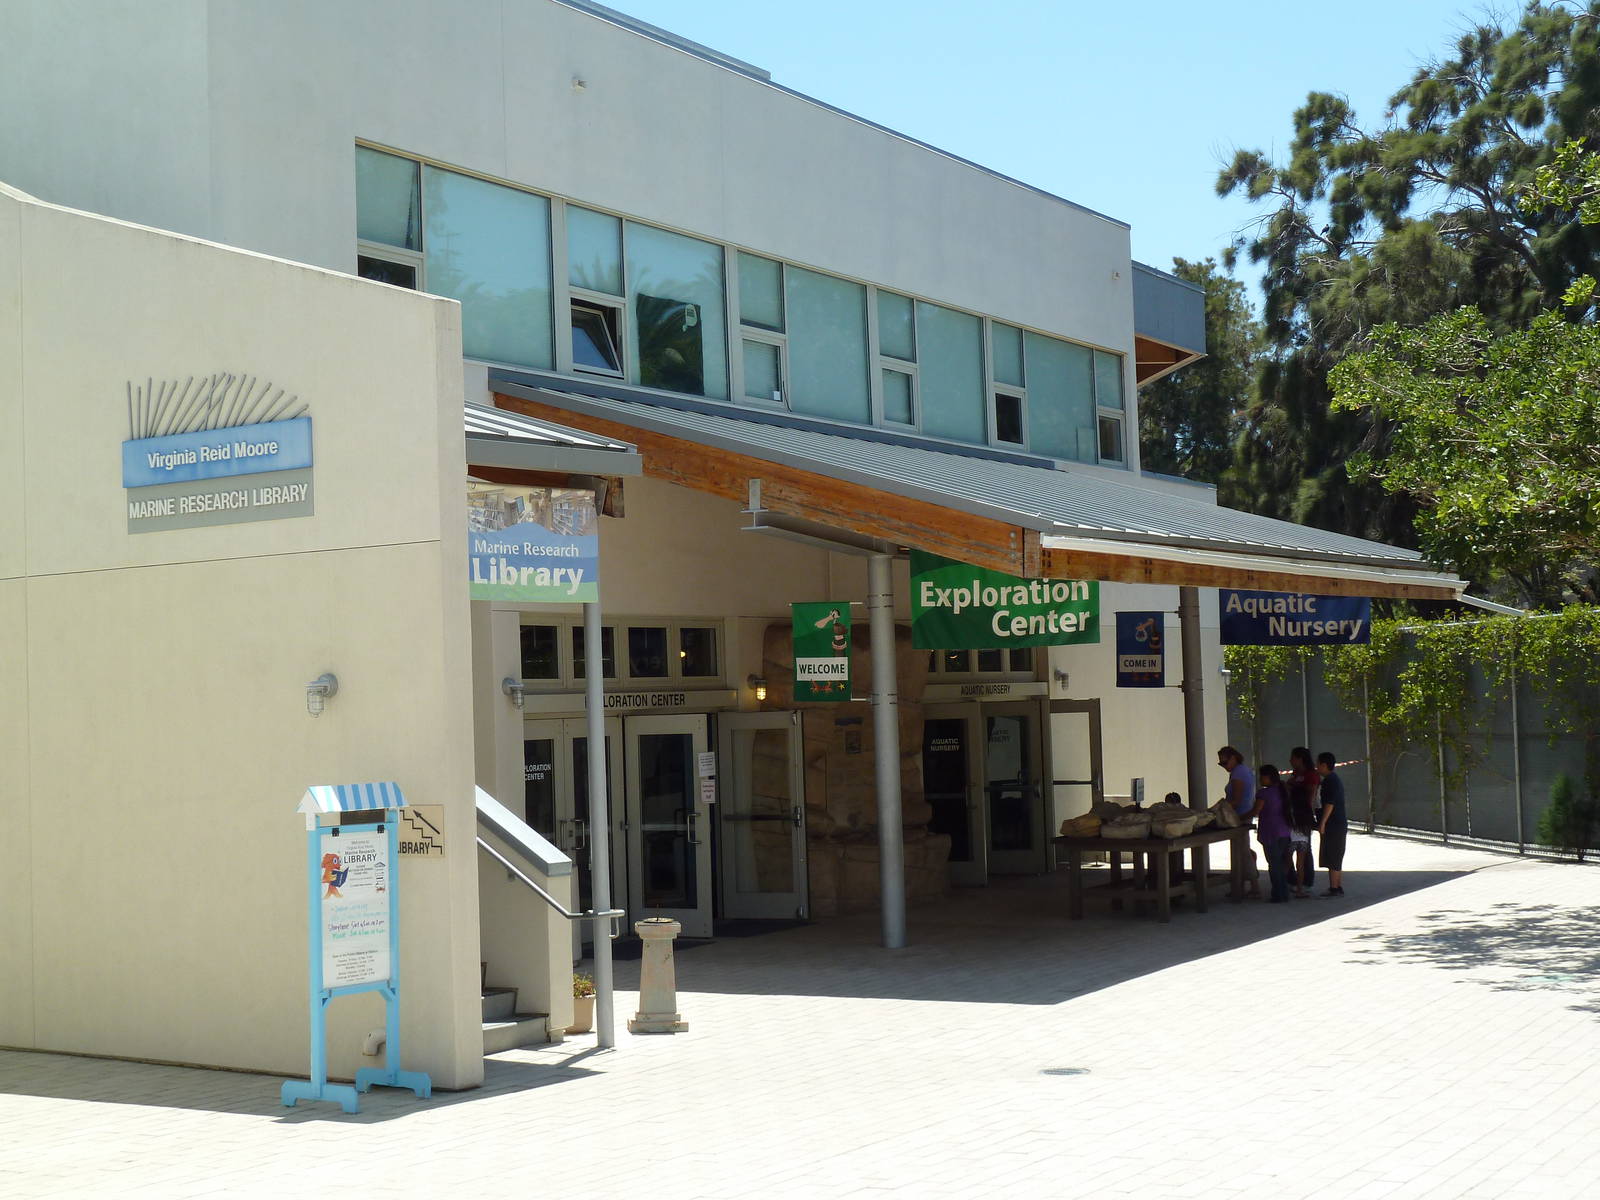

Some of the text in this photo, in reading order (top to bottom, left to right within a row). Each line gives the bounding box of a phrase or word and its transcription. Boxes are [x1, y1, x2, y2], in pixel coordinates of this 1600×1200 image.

[147, 440, 278, 471] Virginia Reid Moore
[129, 483, 308, 519] MARINE RESEARCH LIBRARY
[474, 539, 579, 558] Marine Research
[472, 557, 584, 595] Library
[920, 577, 1090, 615] Exploration
[1225, 592, 1316, 618] Aquatic
[991, 609, 1090, 638] Center
[1268, 615, 1363, 641] Nursery
[798, 663, 845, 675] WELCOME
[1123, 659, 1157, 668] COME IN
[960, 684, 1011, 696] AQUATIC NURSERY
[651, 693, 685, 707] CENTER
[930, 744, 960, 752] NURSERY
[397, 841, 430, 855] IBRARY
[343, 853, 377, 864] LIBRARY
